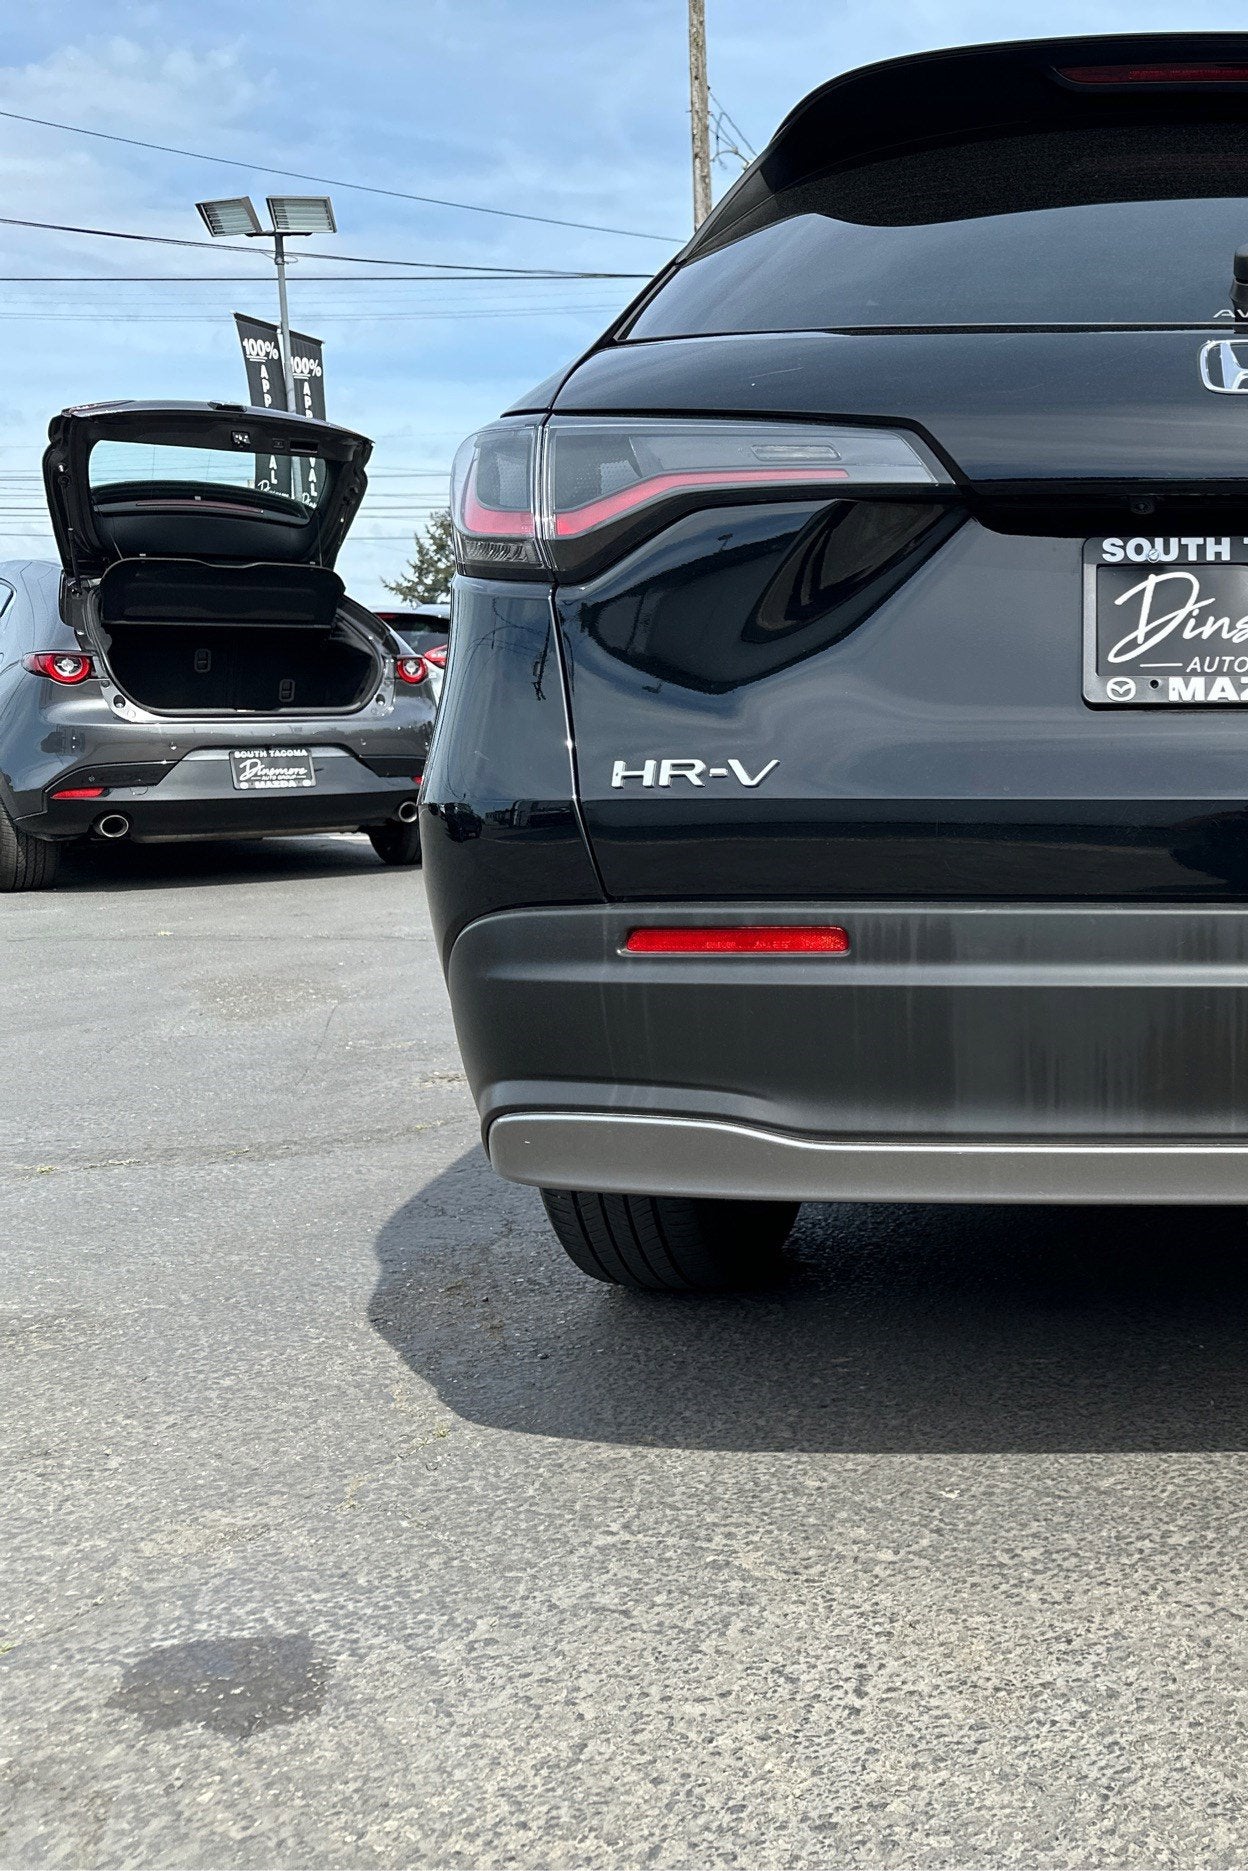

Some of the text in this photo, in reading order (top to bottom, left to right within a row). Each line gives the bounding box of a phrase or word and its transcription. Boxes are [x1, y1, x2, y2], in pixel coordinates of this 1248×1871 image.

[242, 337, 279, 360] 100%
[290, 356, 322, 377] 100%
[1102, 537, 1231, 562] SOUTH
[234, 749, 308, 759] SOUTH TACOMA
[611, 759, 780, 789] HR-V
